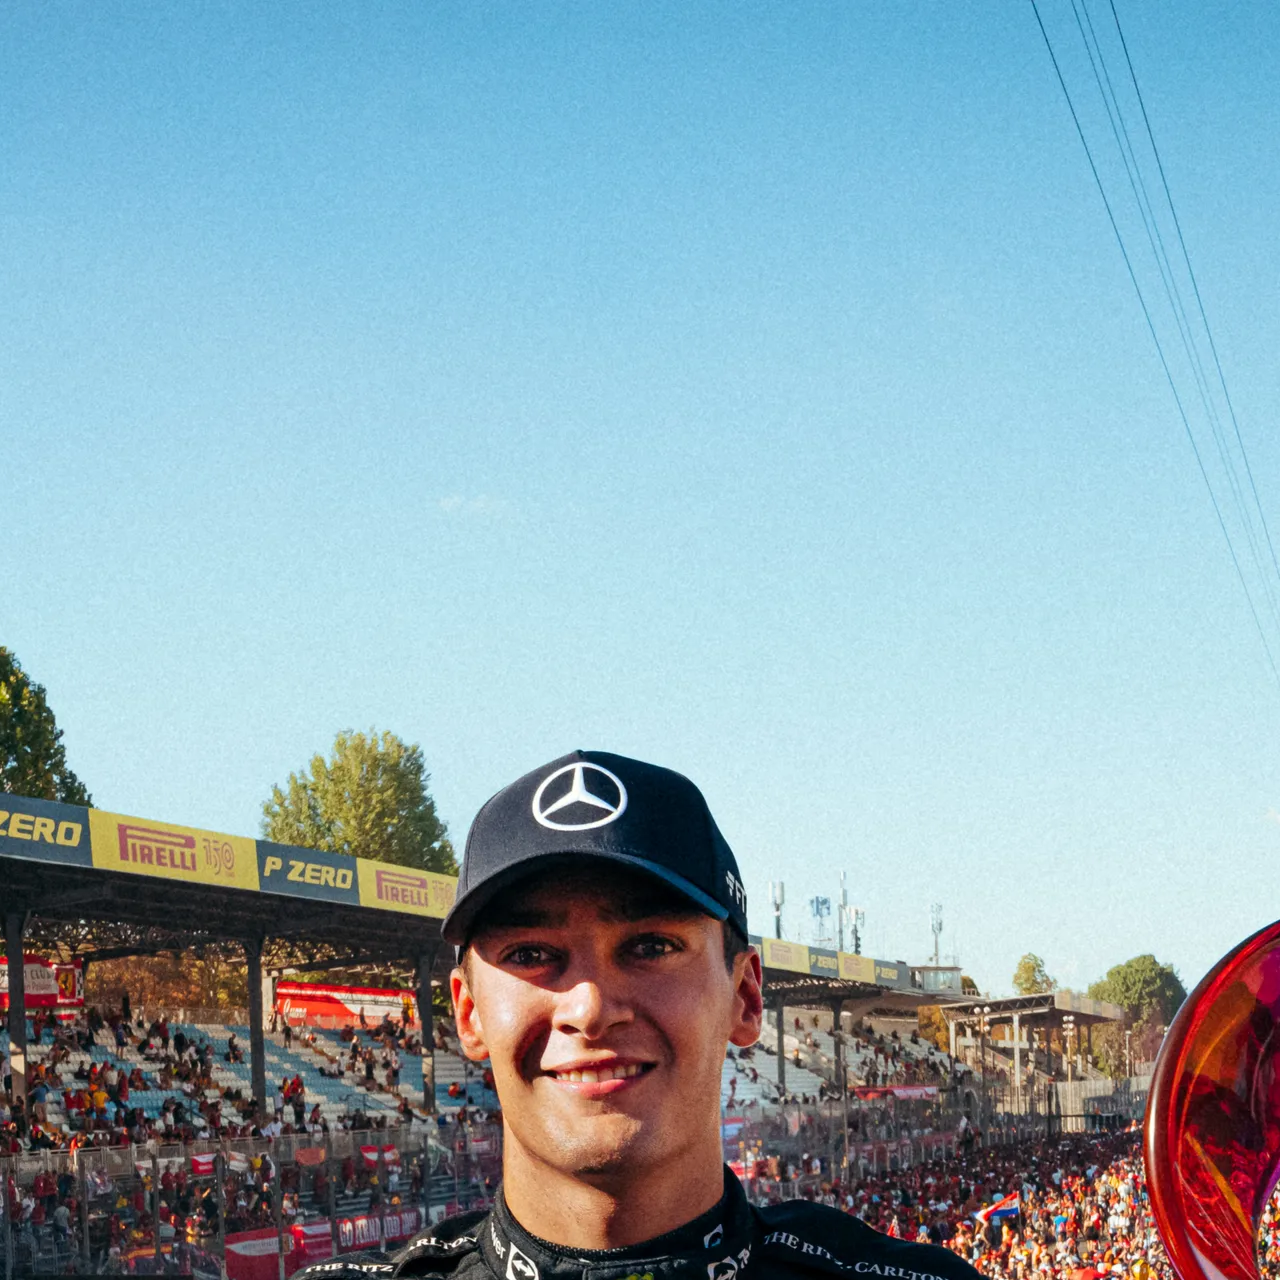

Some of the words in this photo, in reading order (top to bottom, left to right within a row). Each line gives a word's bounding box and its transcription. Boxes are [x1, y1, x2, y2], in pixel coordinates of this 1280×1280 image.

[118, 824, 196, 871] PIRELLI
[204, 838, 235, 875] 150
[264, 856, 282, 877] P
[285, 861, 353, 889] ZERO
[376, 869, 428, 908] PIRELLI
[764, 1231, 800, 1250] THE
[305, 1262, 344, 1274] THE
[347, 1263, 394, 1273] RITZ
